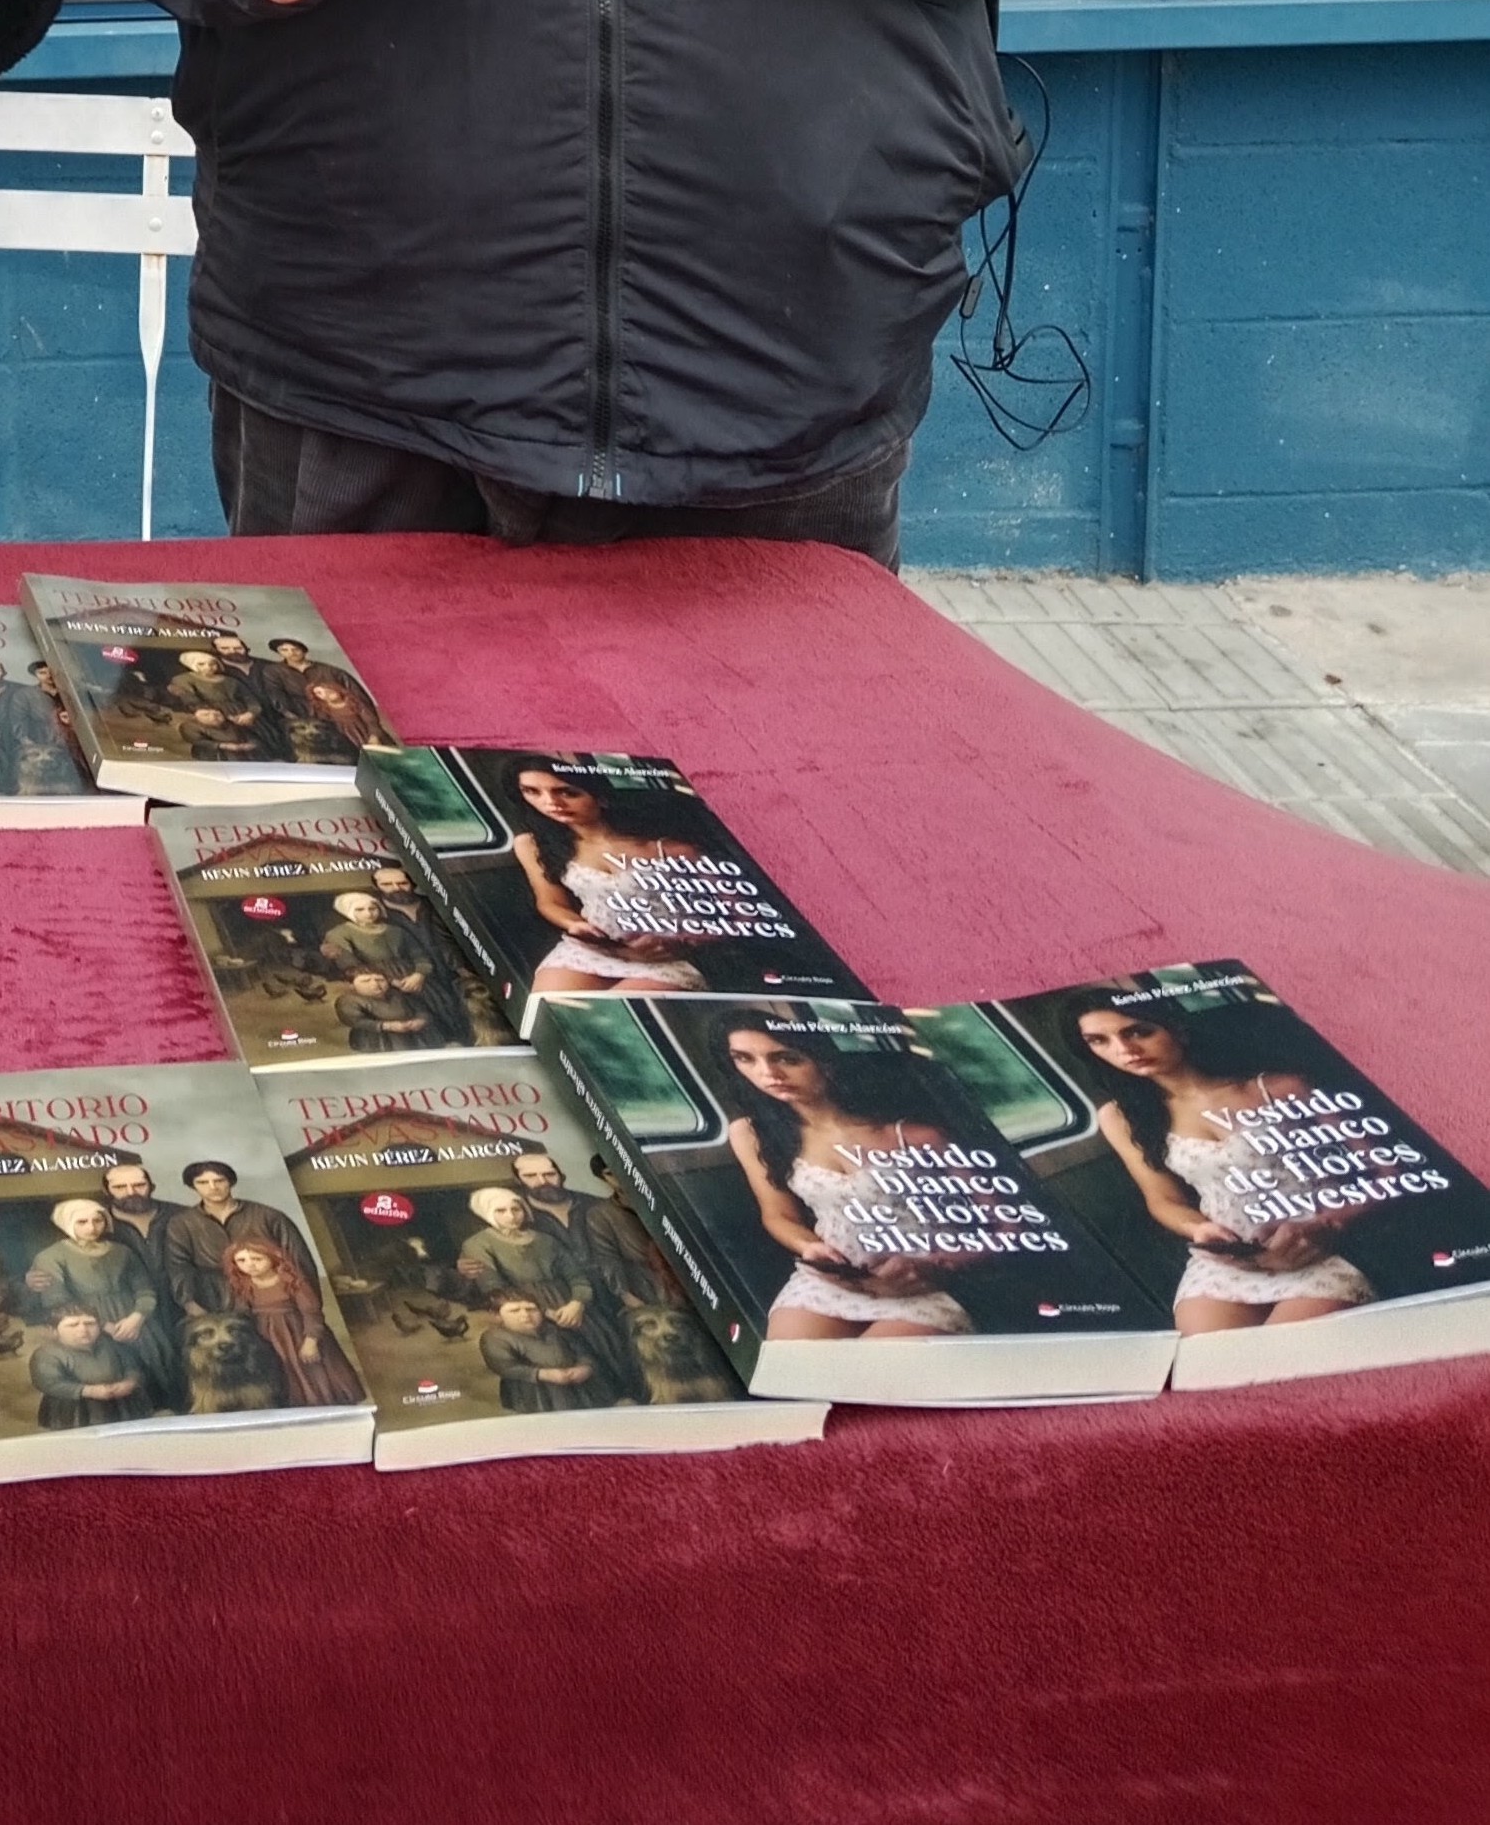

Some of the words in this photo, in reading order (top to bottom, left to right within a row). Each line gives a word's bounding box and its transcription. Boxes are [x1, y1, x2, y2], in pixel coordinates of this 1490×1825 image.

[186, 816, 385, 845] TERRITORI
[201, 866, 251, 882] KEVIN
[253, 861, 306, 879] PÉREZ
[309, 856, 382, 874] ALARCÓN
[602, 851, 742, 878] Vestido
[634, 873, 759, 897] blanco
[607, 892, 652, 915] de
[664, 891, 778, 919] flores
[616, 912, 797, 940] silvestres
[288, 1082, 541, 1121] TERRITORIO
[1202, 1089, 1363, 1133] Vestido
[302, 1111, 550, 1149] DEVASTADO
[1250, 1112, 1391, 1157] blanco
[30, 1151, 118, 1172] ALARCÓN
[310, 1153, 369, 1171] KEVIN
[372, 1146, 435, 1167] PÉREZ
[437, 1140, 523, 1162] ALARCÓN
[833, 1142, 998, 1171] Vestido
[1223, 1166, 1279, 1197] de
[1284, 1140, 1421, 1182] flores
[871, 1168, 1020, 1197] blanco
[1243, 1164, 1450, 1225] silvestres
[844, 1196, 901, 1225] de
[908, 1192, 1047, 1226] flores
[857, 1223, 1069, 1255] silvestres
